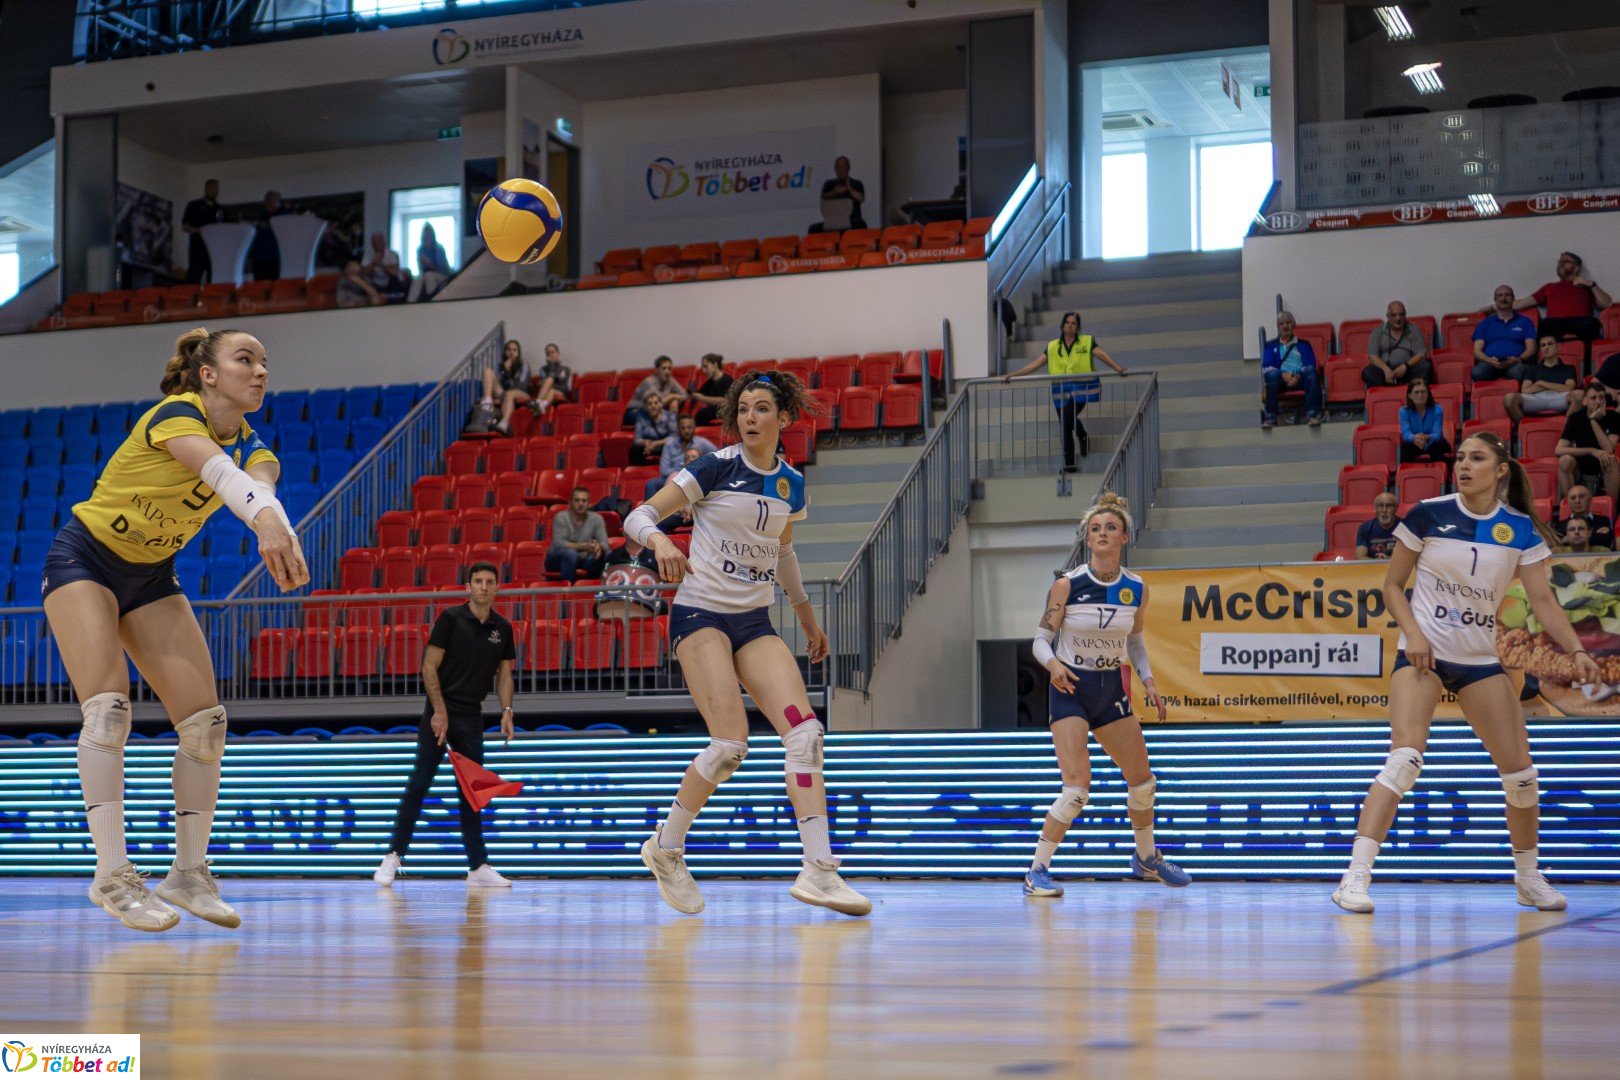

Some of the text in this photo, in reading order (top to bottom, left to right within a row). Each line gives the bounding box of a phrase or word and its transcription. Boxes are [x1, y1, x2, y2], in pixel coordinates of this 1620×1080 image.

[474, 28, 584, 51] NYÍREGYHÁZA
[694, 153, 783, 171] NYÍREGYHÁZA
[694, 164, 814, 197] Többet ad!
[1400, 205, 1425, 220] BH
[1535, 195, 1561, 210] BH
[1271, 216, 1295, 229] BH
[756, 499, 769, 532] 11
[1470, 546, 1478, 577] 1
[1096, 606, 1118, 629] 17
[1221, 640, 1359, 670] Roppanj rá!
[1184, 694, 1221, 707] hazai
[1224, 692, 1344, 707] csirkemellfilével,
